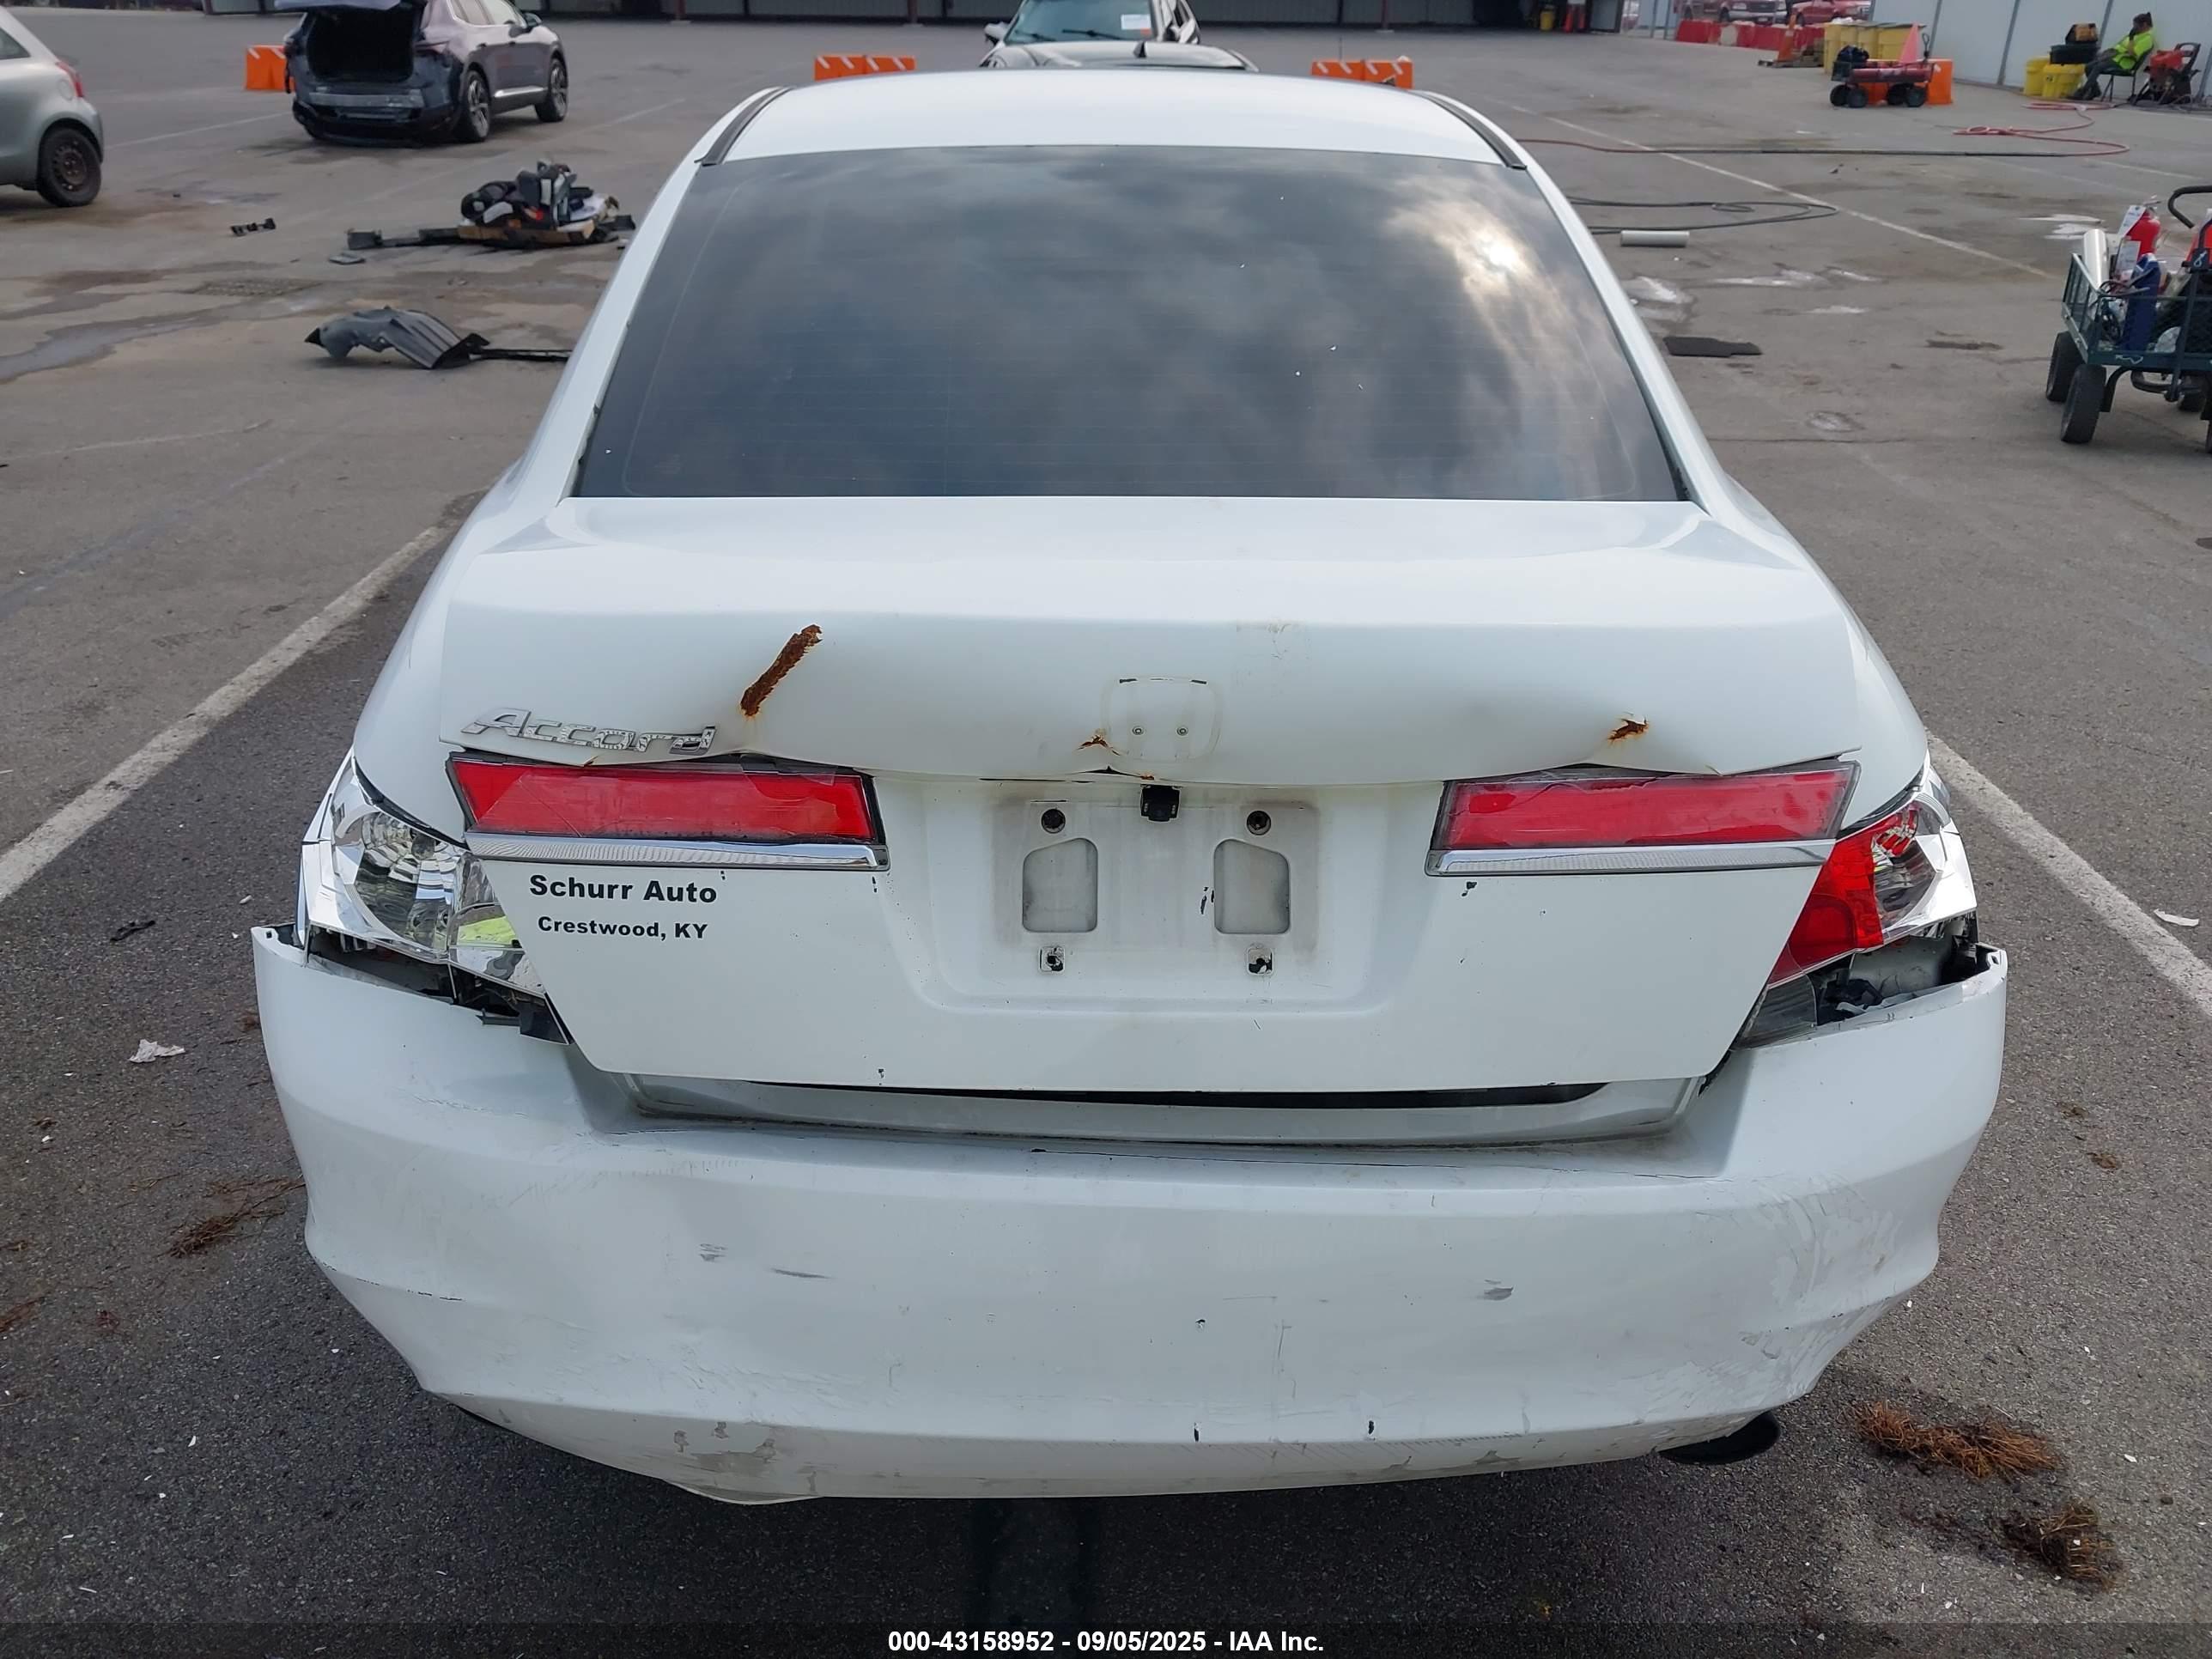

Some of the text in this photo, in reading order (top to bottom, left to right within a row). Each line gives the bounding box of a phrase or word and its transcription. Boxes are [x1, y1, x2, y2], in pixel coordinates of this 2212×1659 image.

[460, 707, 717, 756] Accord
[529, 874, 717, 903] Schurr Auto
[538, 915, 708, 942] Crestwood, KY
